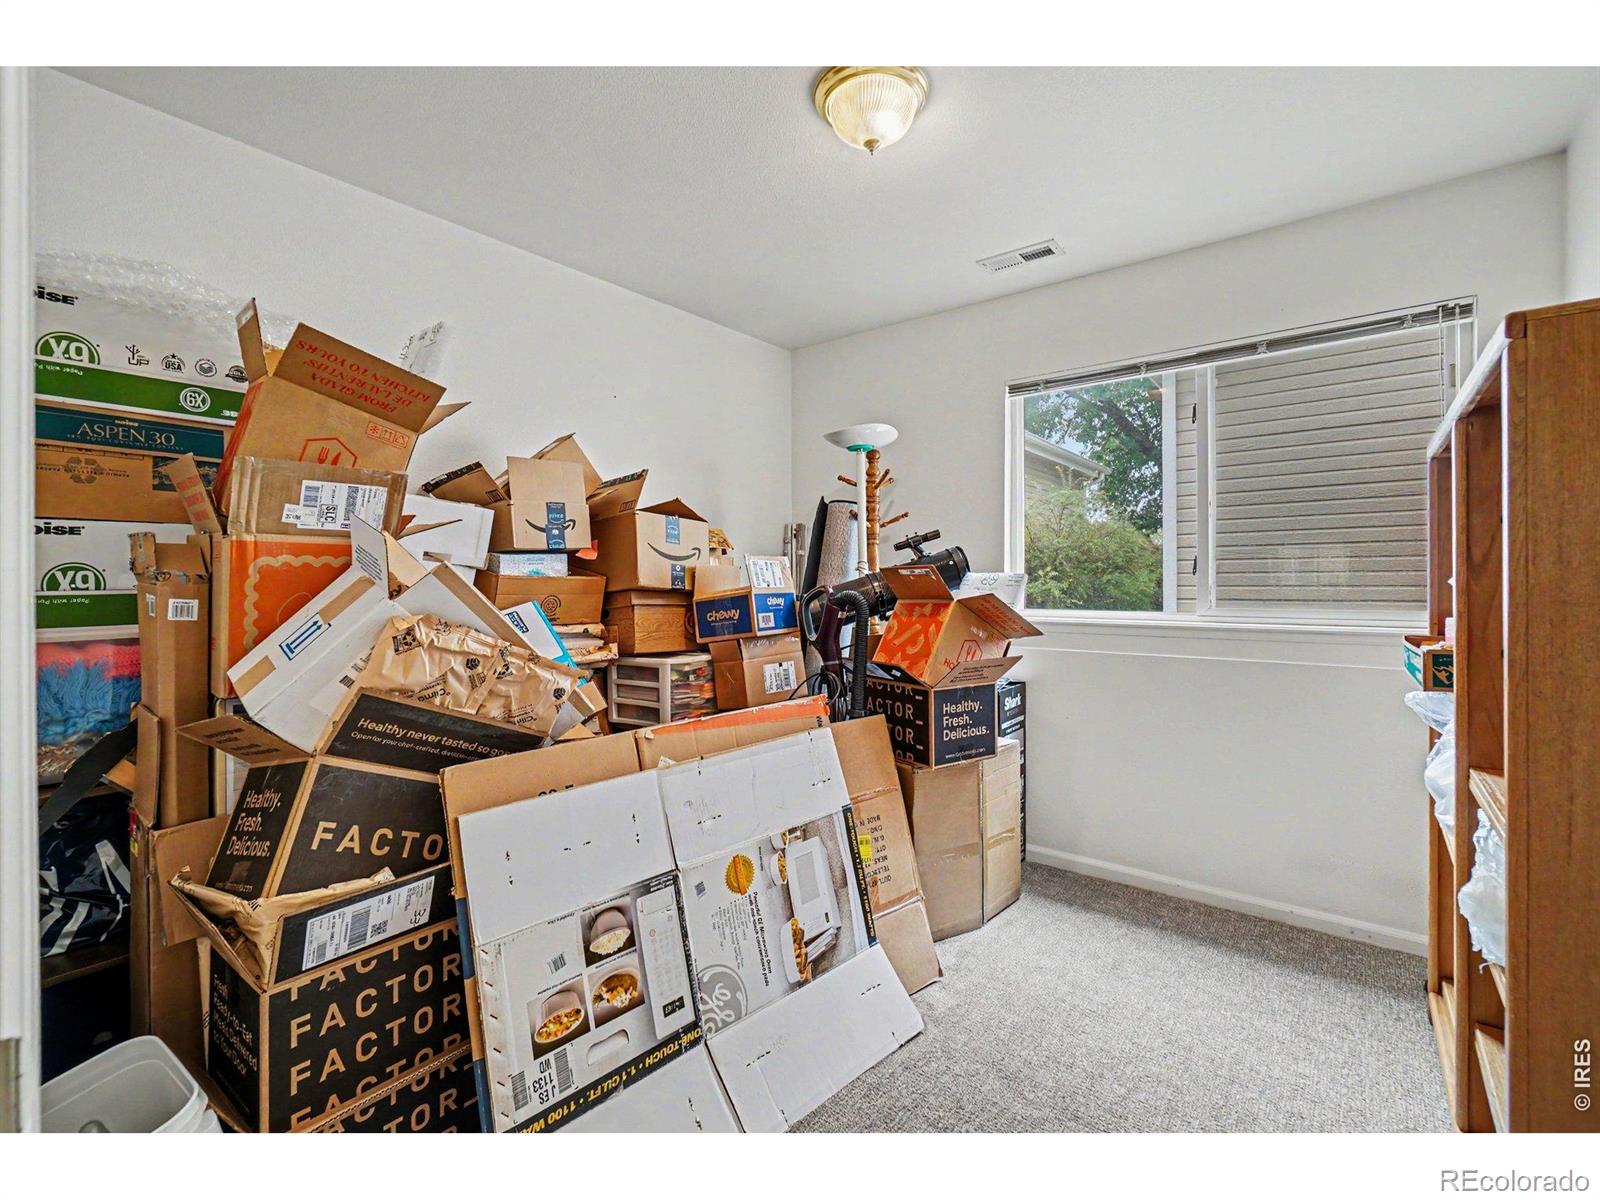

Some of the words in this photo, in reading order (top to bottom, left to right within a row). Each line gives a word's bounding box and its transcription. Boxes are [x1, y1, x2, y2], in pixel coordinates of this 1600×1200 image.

[295, 339, 347, 367] YOURS
[349, 363, 370, 377] TO
[370, 372, 431, 402] KITCHEN
[357, 391, 399, 414] FROM
[394, 394, 414, 408] DE
[77, 423, 146, 443] ASPEN
[149, 431, 176, 447] 30
[324, 505, 337, 522] SLC
[766, 596, 785, 606] chewy
[706, 608, 740, 622] chewy
[943, 700, 983, 715] Healthy.
[1004, 692, 1021, 711] Shark
[943, 713, 973, 728] Fresh.
[351, 731, 372, 741] Open
[372, 735, 382, 743] for
[358, 717, 407, 738] Healthy
[407, 730, 442, 744] never
[441, 736, 478, 751] tasted
[478, 744, 490, 754] so
[943, 725, 990, 741] Delicious.
[243, 788, 281, 813] Healthy.
[234, 811, 263, 832] Fresh.
[226, 835, 271, 857] Delicious.
[310, 820, 445, 862] FACTO
[290, 952, 461, 1050] FACTOR
[290, 992, 461, 1097] FACTOR
[645, 1027, 704, 1067] ONE-TOUCH
[538, 1057, 553, 1073] WD
[620, 1067, 638, 1080] 1.1
[532, 1072, 554, 1092] 1133
[538, 1090, 551, 1105] ES
[547, 1103, 578, 1119] 1100
